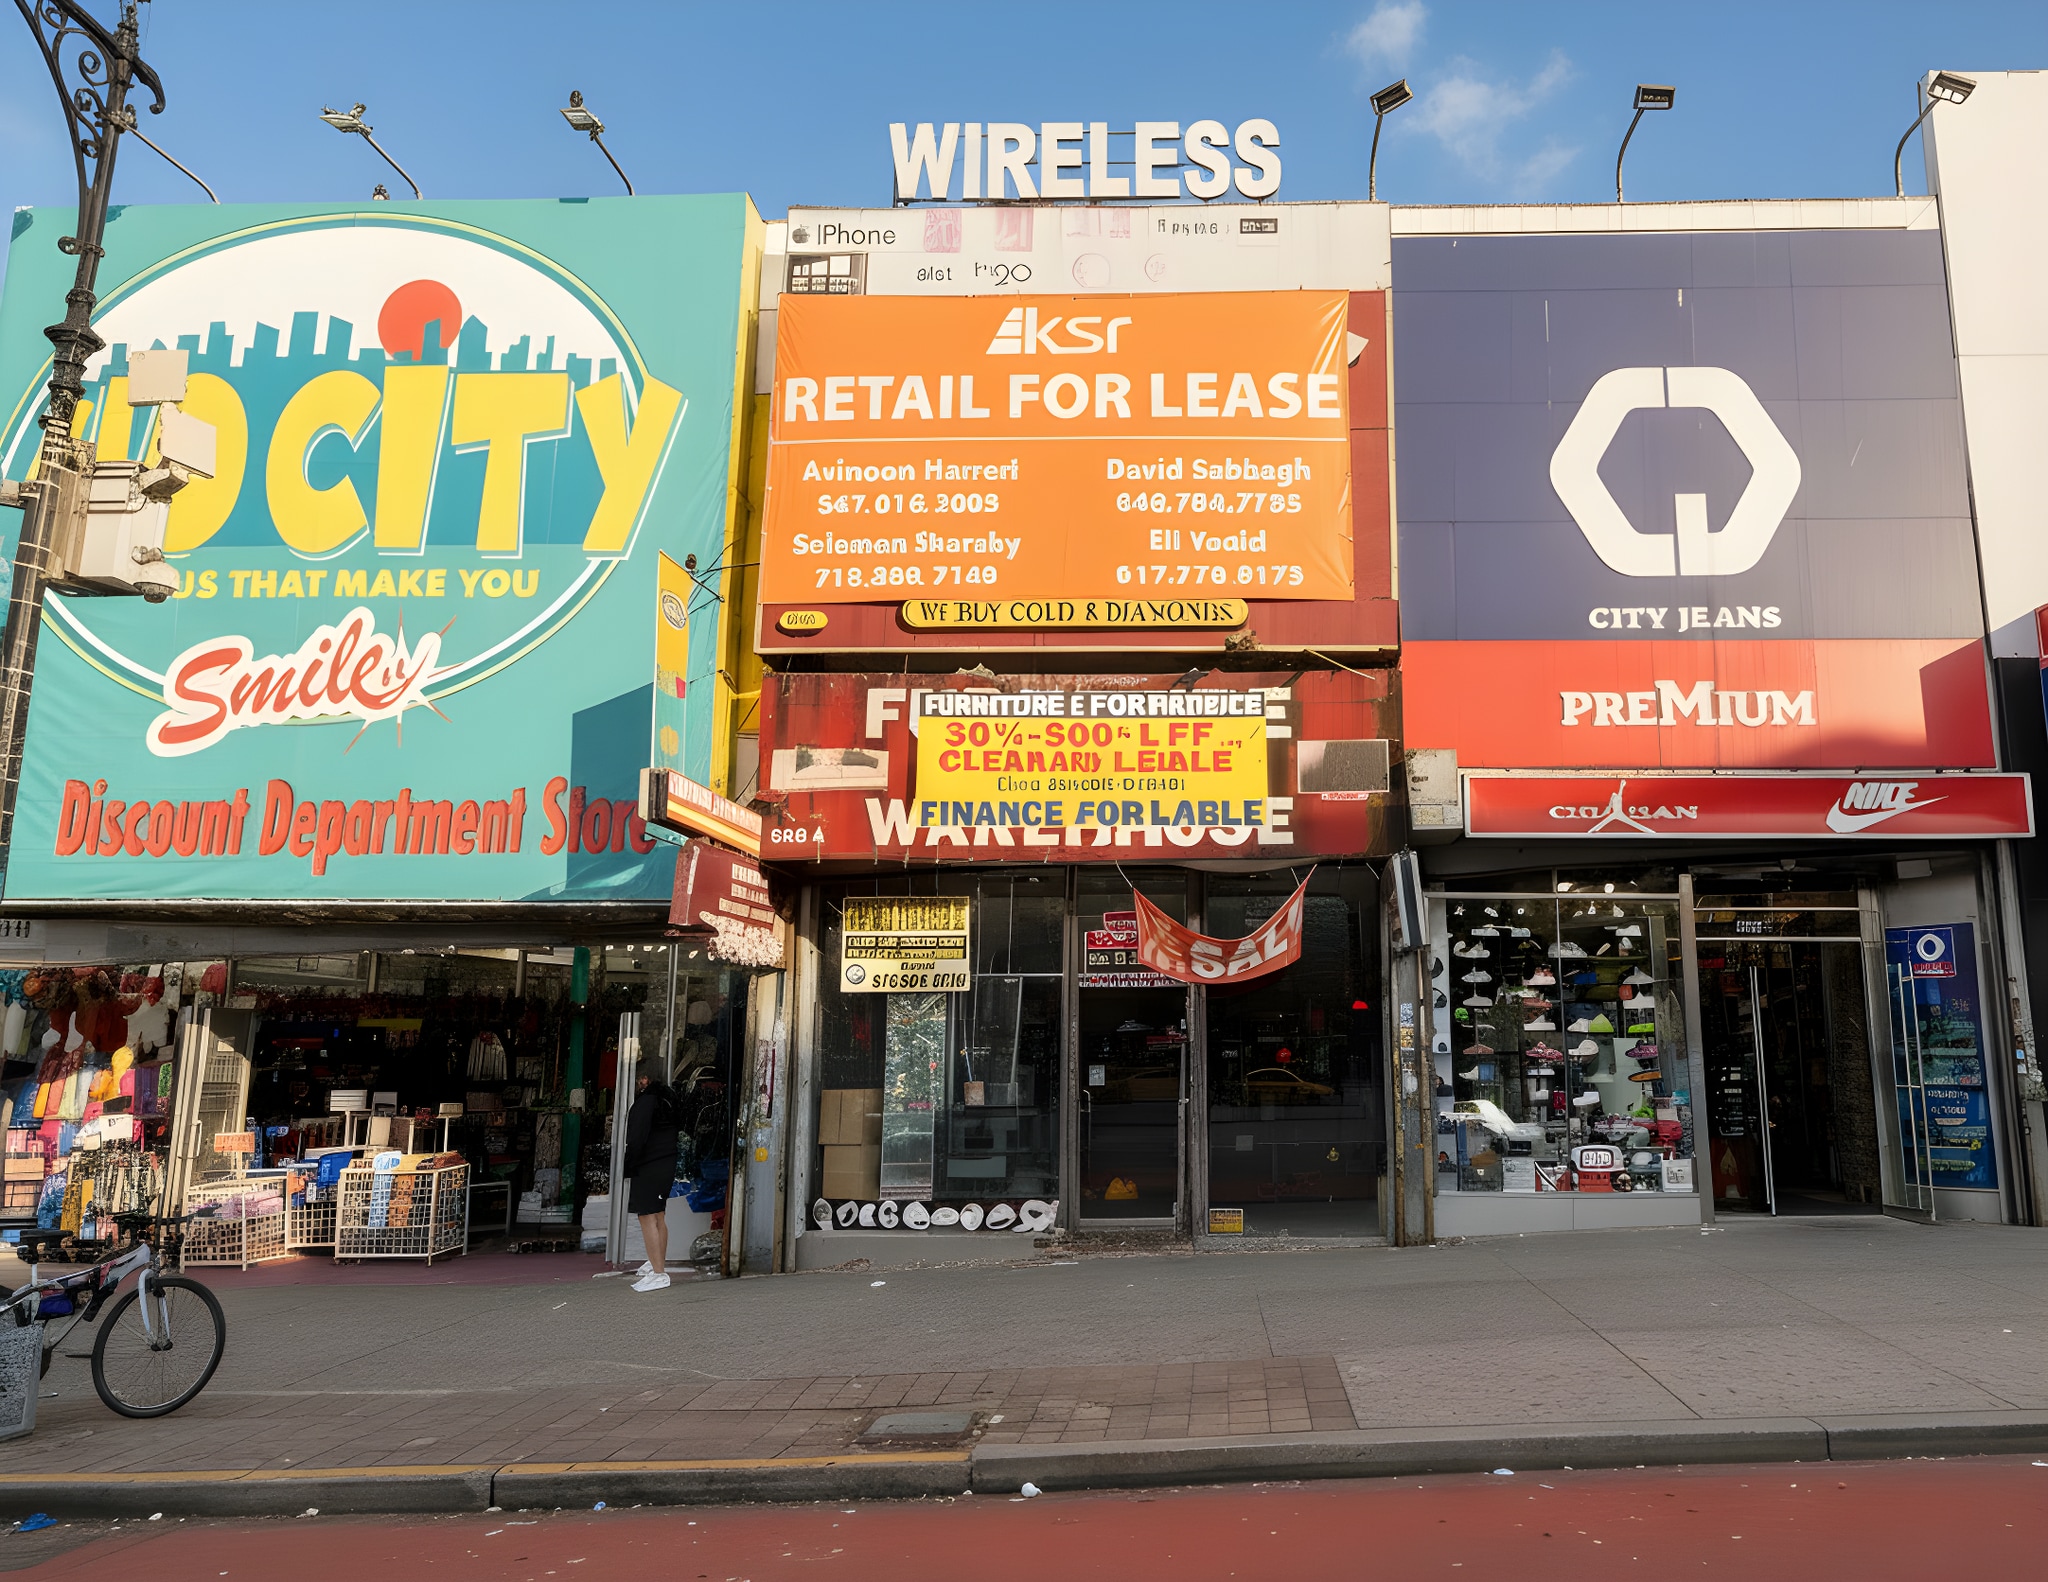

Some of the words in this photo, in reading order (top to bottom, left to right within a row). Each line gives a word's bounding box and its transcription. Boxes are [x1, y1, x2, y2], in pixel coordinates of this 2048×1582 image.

[889, 118, 1282, 199] WIRELESS
[784, 375, 991, 422] RETAIL
[1009, 373, 1132, 419] FOR
[1150, 372, 1341, 419] LEASE
[266, 364, 687, 555] CITY
[1107, 458, 1184, 480] David
[228, 570, 328, 599] THAT
[334, 568, 447, 598] MAKE
[459, 568, 541, 598] YOU
[954, 602, 1002, 622] BUY
[1588, 607, 1669, 629] CITY
[1678, 606, 1782, 633] JEANS
[1560, 679, 1817, 727] PREMIUM
[54, 778, 251, 858] Discount
[258, 778, 528, 877] Department
[920, 801, 1064, 827] FINANCE
[1074, 800, 1144, 827] FOR
[1150, 800, 1264, 827] LABLE
